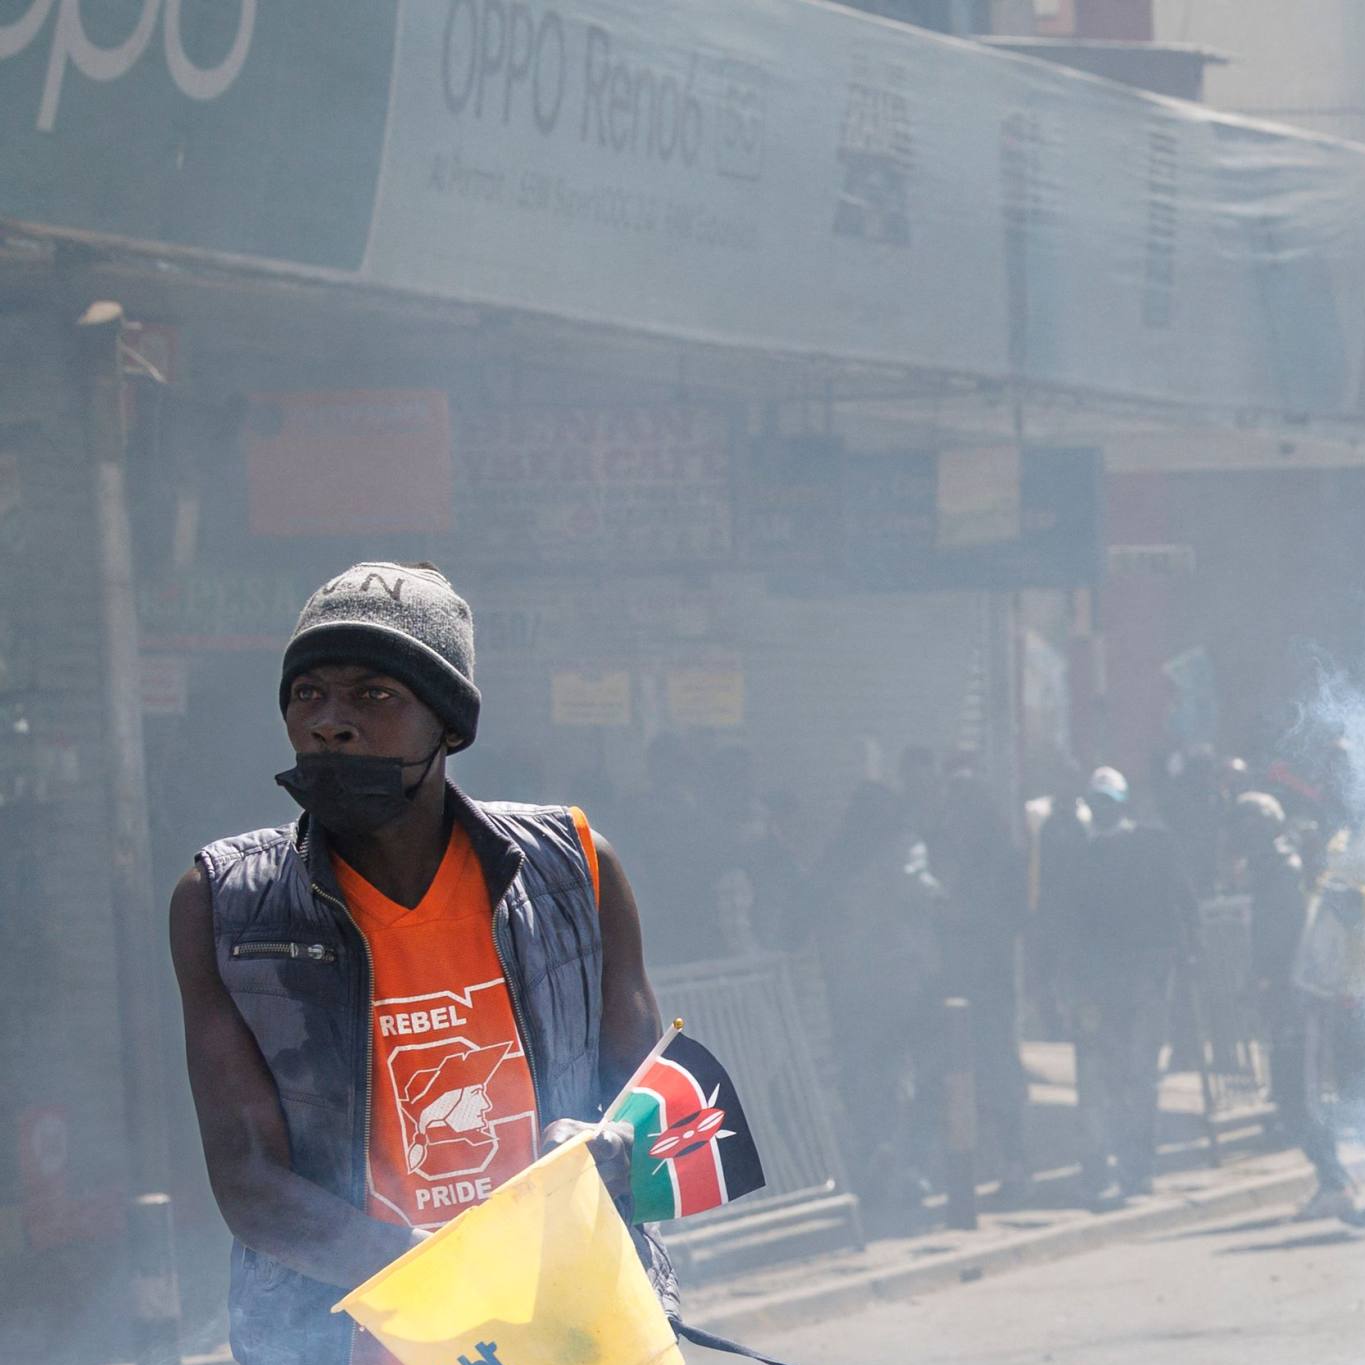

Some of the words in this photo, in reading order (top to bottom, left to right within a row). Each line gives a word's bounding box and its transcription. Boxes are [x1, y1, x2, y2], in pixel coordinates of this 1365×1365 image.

[442, 0, 567, 137] OPPO
[379, 1006, 467, 1037] REBEL
[415, 1177, 492, 1210] PRIDE
